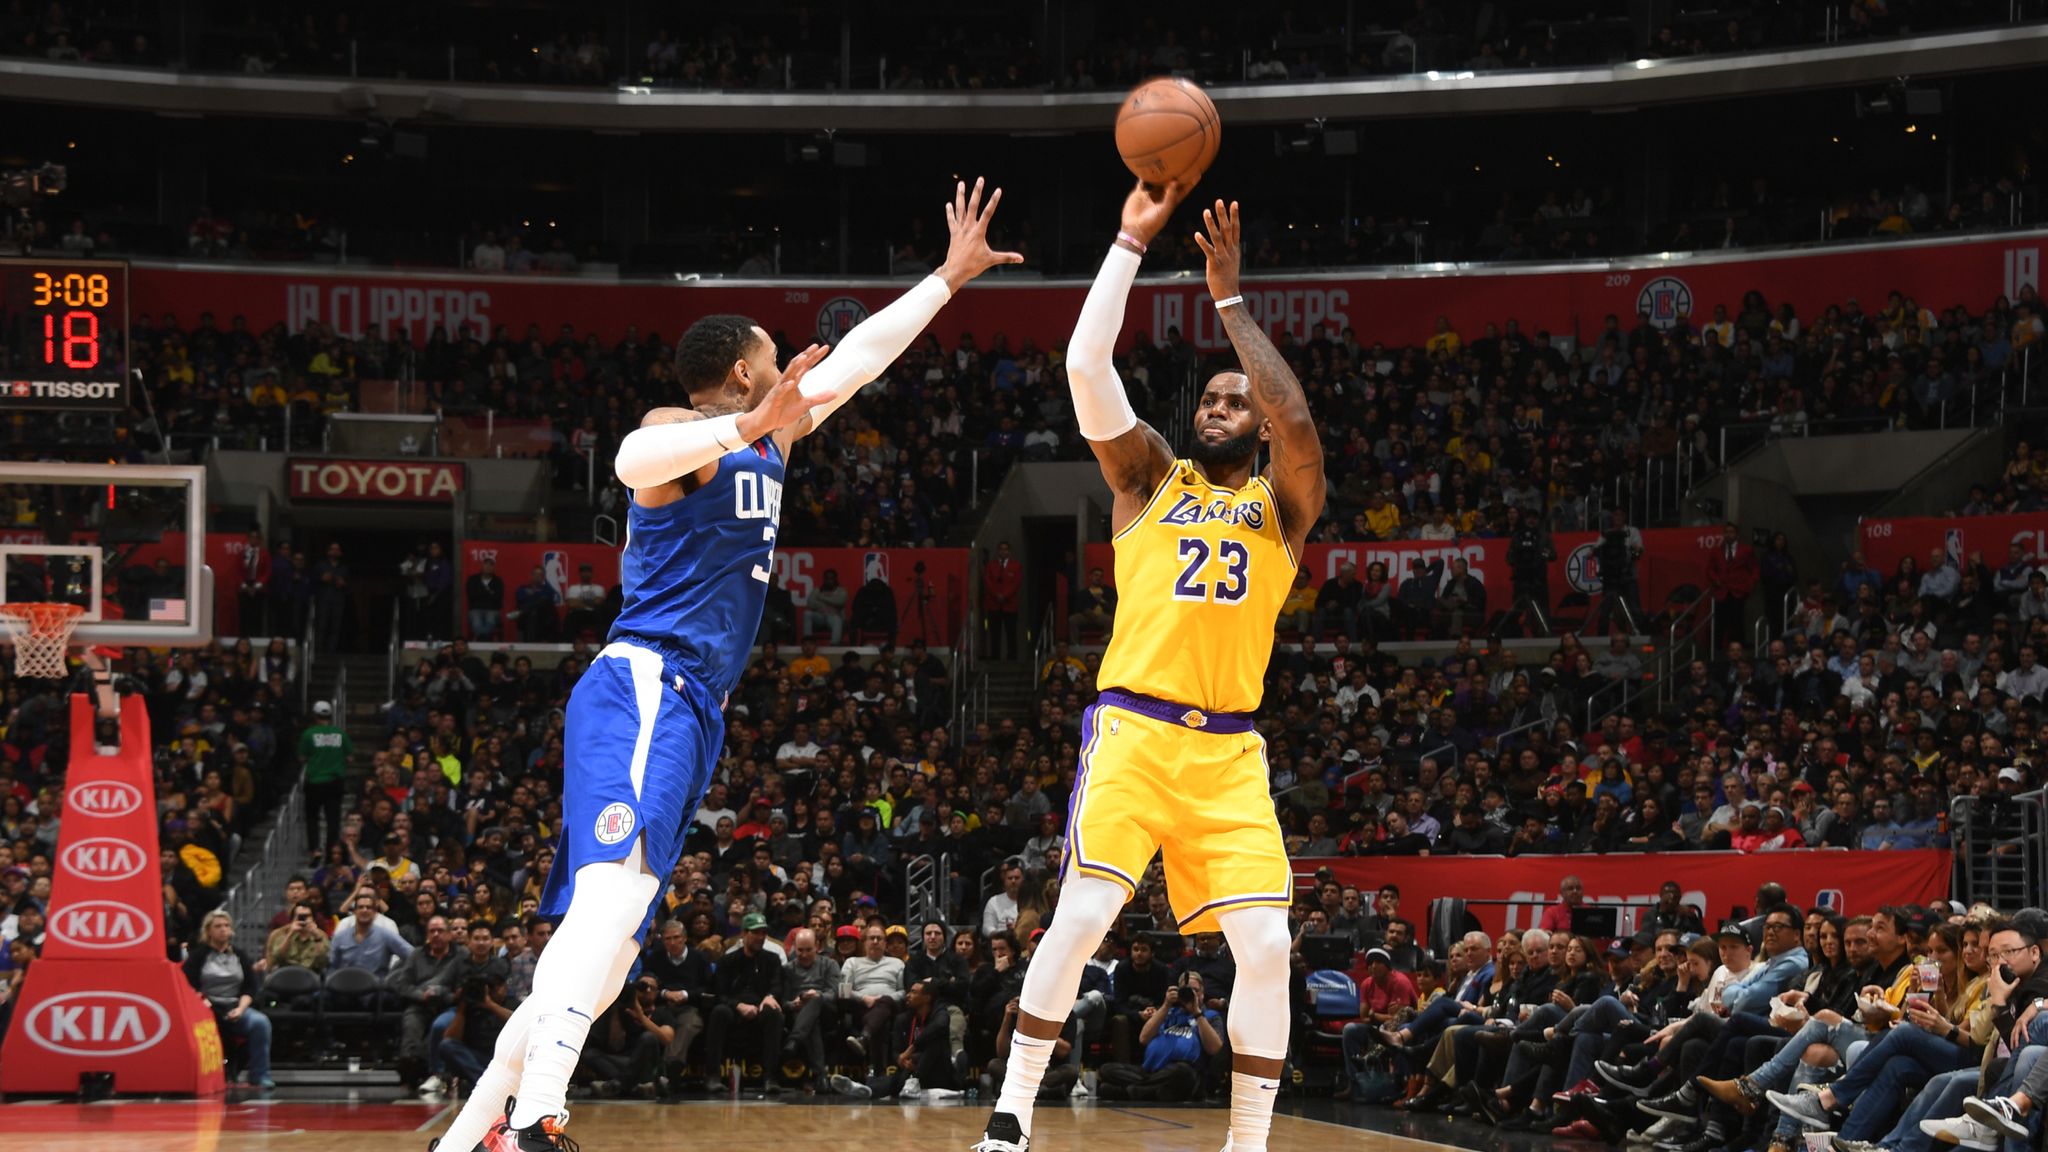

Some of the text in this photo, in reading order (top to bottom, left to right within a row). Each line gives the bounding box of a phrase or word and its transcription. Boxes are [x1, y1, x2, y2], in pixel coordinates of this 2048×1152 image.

[33, 272, 109, 308] 3:08
[785, 291, 809, 304] 208
[1605, 275, 1631, 288] 209
[331, 286, 491, 345] CLIPPERS
[1193, 289, 1350, 349] CLPPERS
[44, 311, 99, 368] 18
[32, 381, 120, 399] TISSOT
[293, 464, 457, 496] TOYOTA
[1158, 491, 1264, 530] LAKERS
[1866, 523, 1892, 539] 108
[1172, 537, 1249, 606] 23
[81, 789, 130, 809] KIA
[76, 847, 133, 871] KIA
[67, 911, 137, 939] KIA
[51, 1005, 147, 1042] KIA
